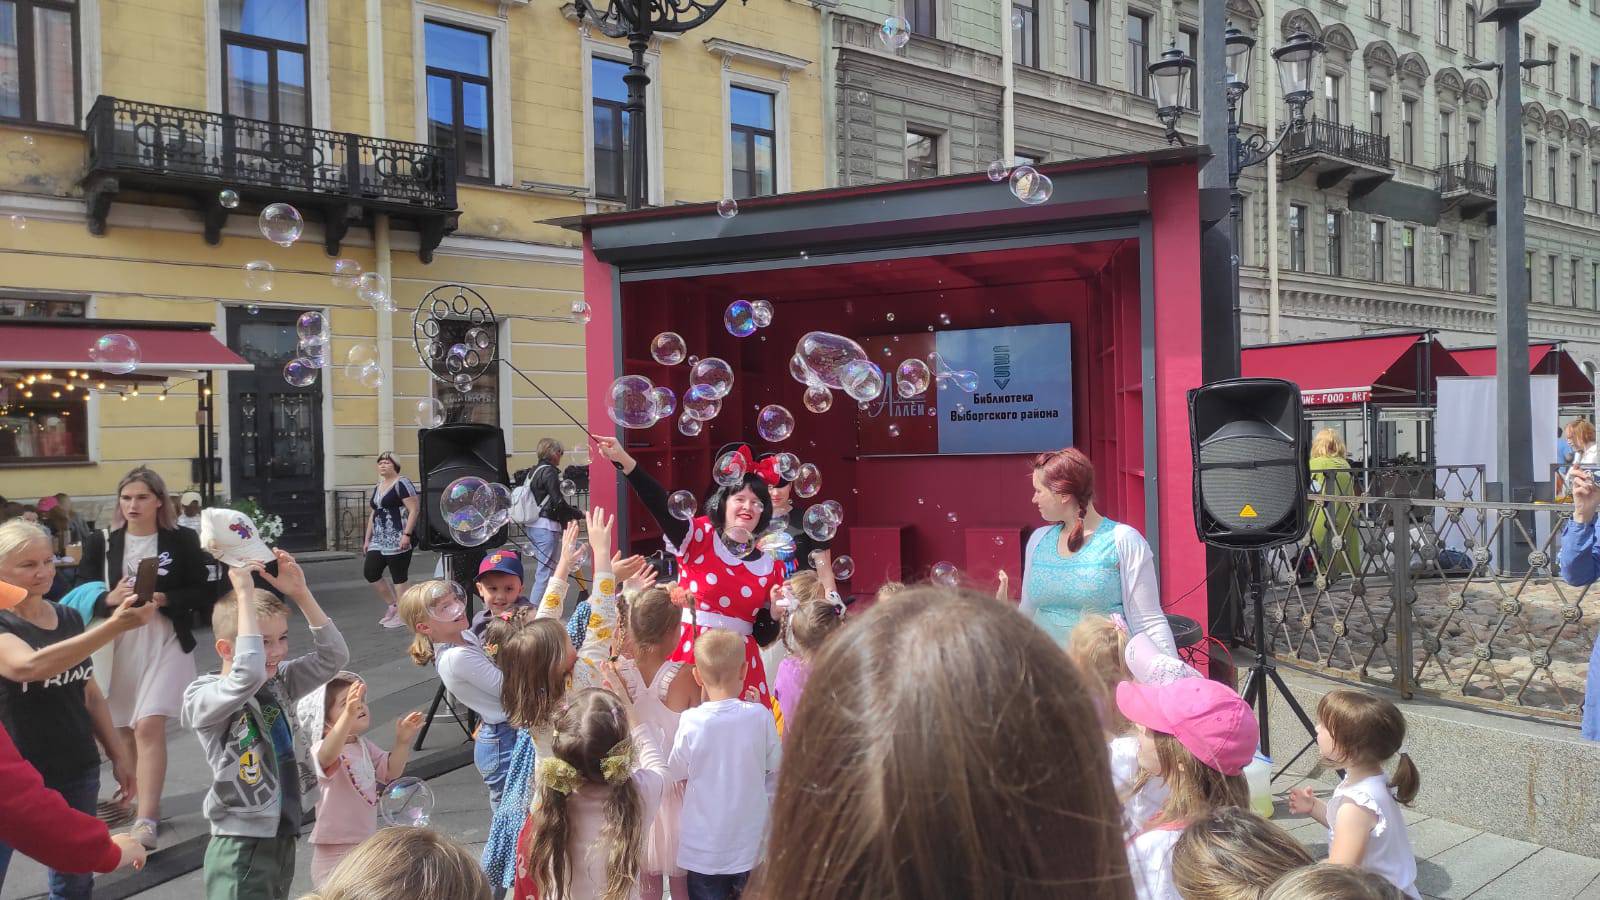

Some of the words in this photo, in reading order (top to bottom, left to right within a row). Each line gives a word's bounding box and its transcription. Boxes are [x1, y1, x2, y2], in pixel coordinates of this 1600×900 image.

[973, 393, 1034, 404] Библиотека
[1322, 393, 1344, 404] FOOD
[1351, 391, 1368, 402] ART
[950, 410, 1018, 422] Выборгского
[1020, 408, 1059, 421] района
